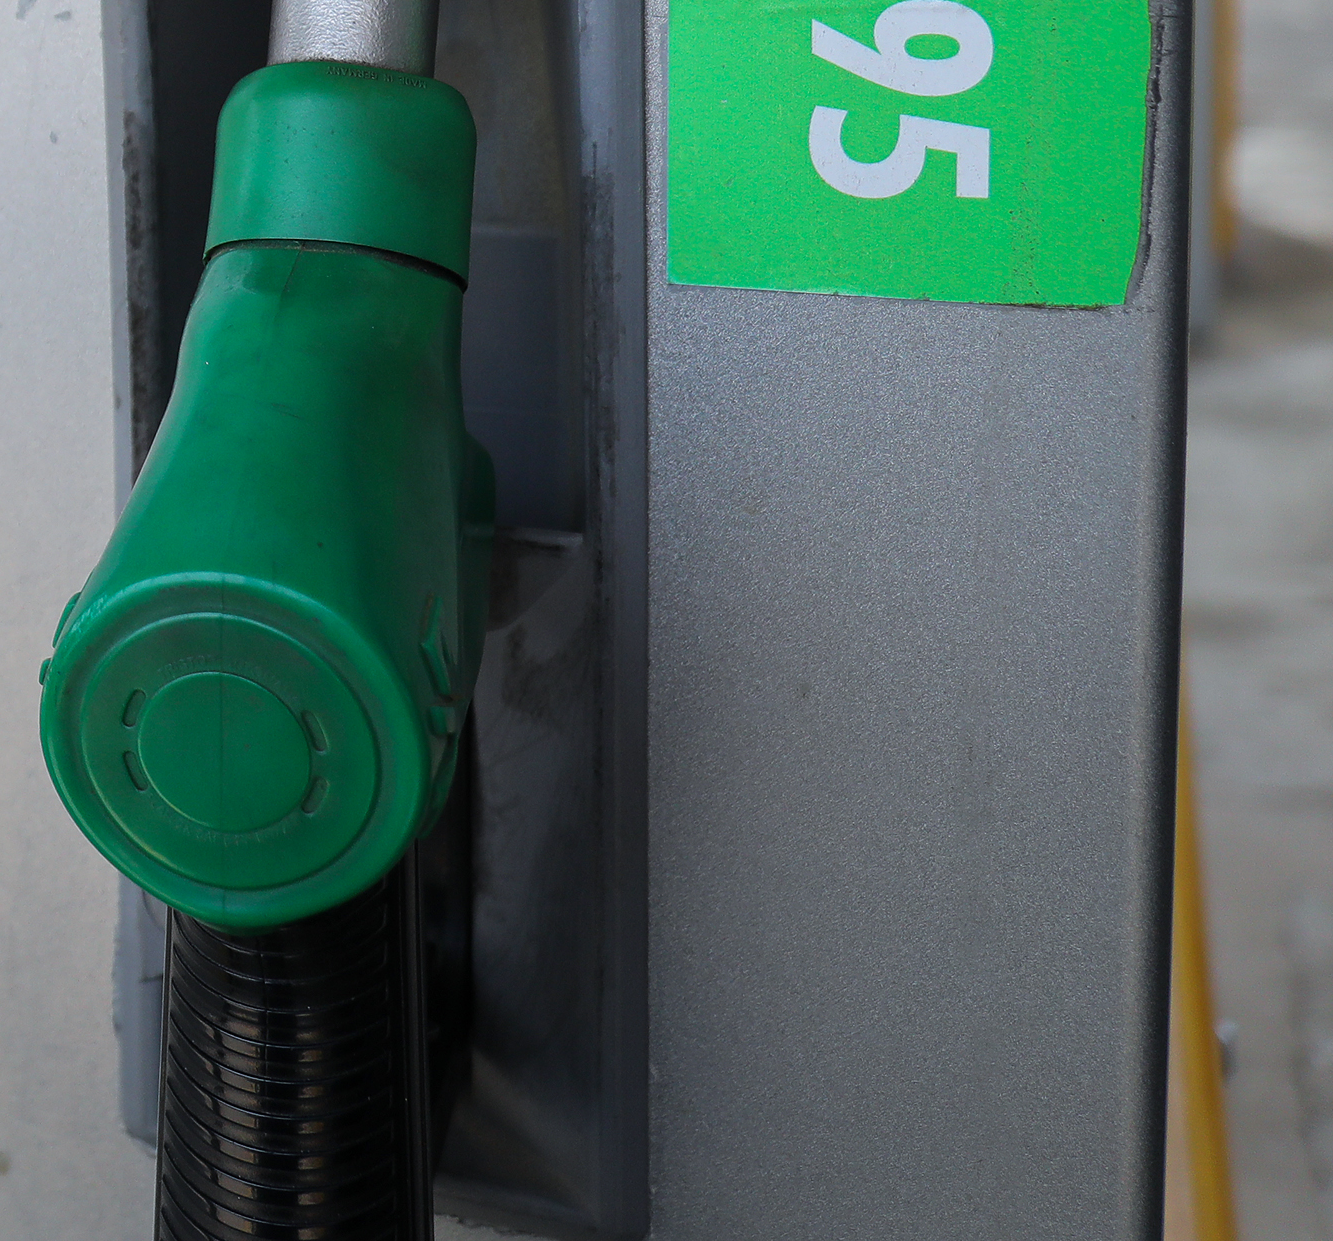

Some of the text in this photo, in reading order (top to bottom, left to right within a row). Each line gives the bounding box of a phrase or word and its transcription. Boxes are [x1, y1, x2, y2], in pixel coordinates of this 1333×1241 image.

[326, 66, 428, 89] MADE IN GERMANY
